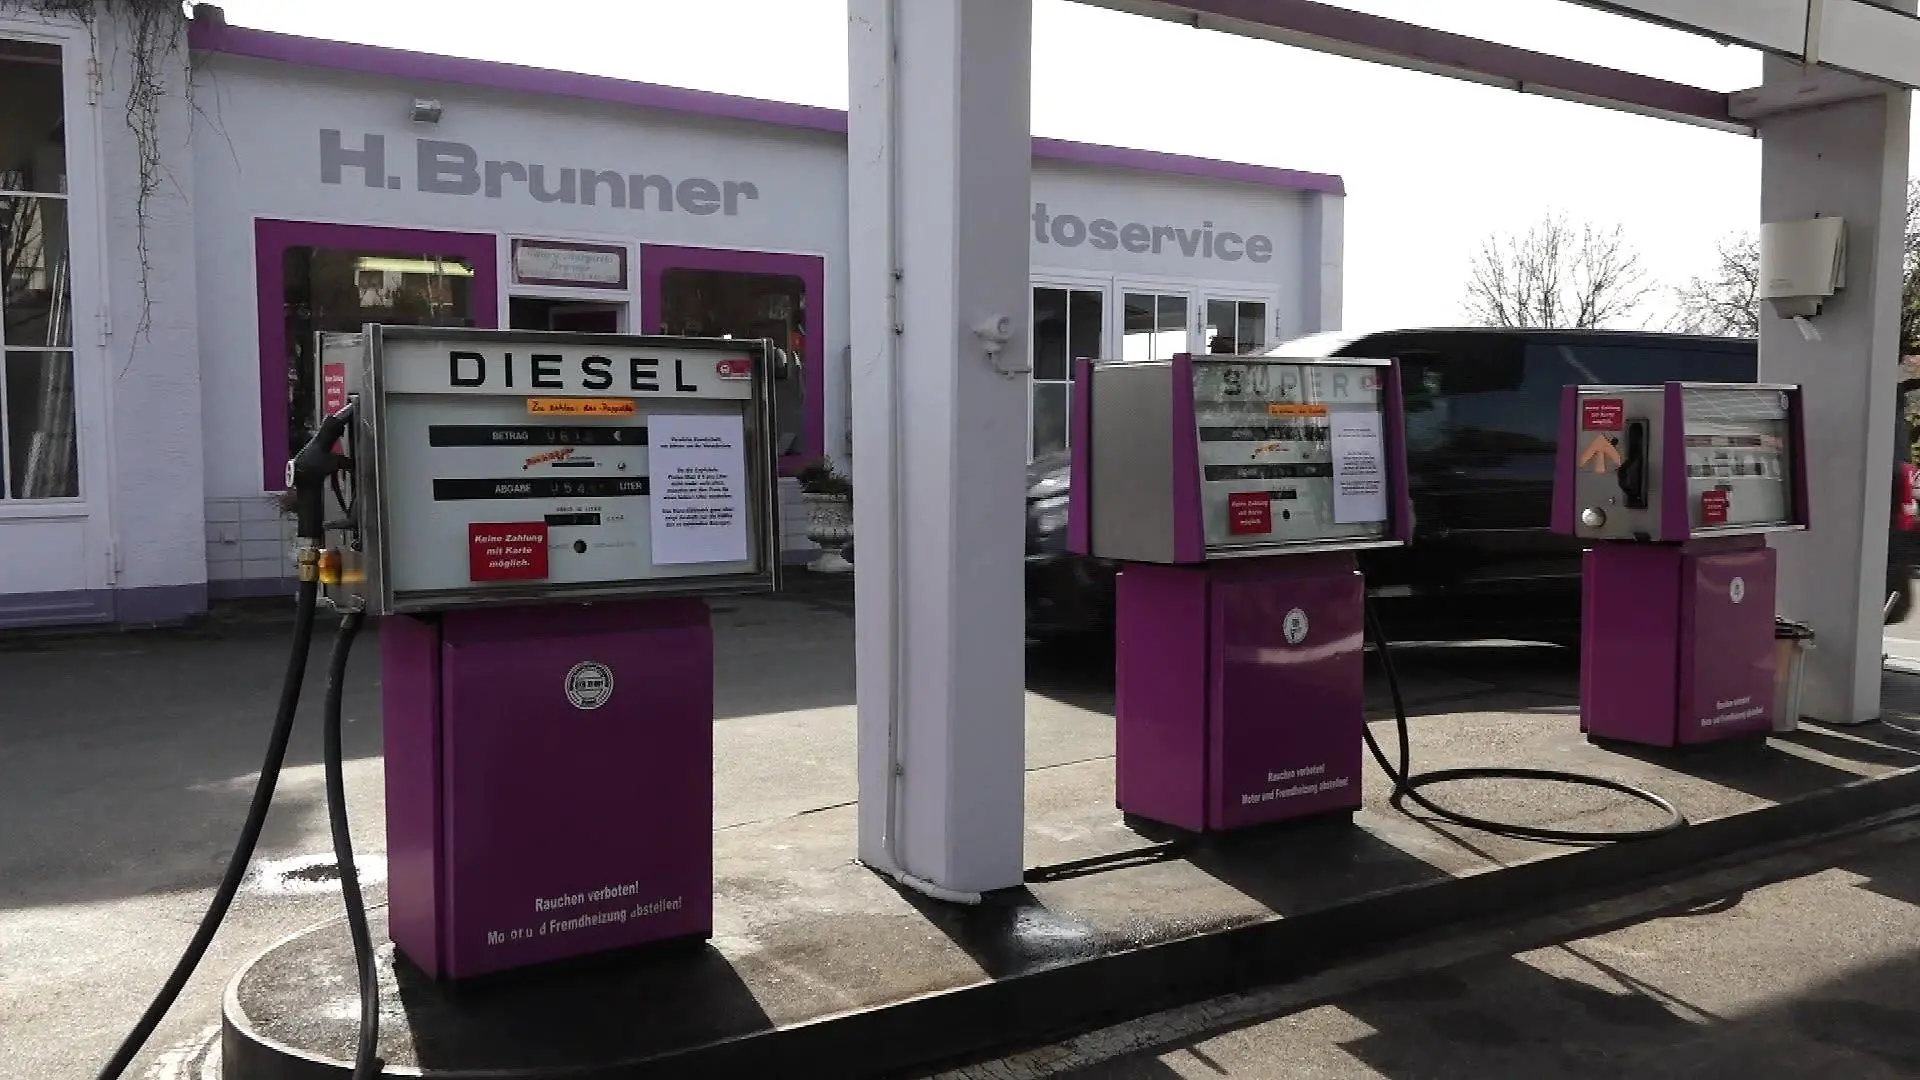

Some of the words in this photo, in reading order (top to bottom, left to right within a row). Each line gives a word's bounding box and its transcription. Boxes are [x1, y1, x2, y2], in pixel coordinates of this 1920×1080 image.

[320, 128, 401, 190] H.
[416, 138, 759, 216] Brunner
[450, 351, 698, 392] DIESEL
[1223, 368, 1349, 398] SUPER
[492, 431, 529, 440] BETRAG
[619, 481, 642, 490] LITER
[474, 535, 503, 543] Keine
[505, 534, 543, 543] Zahlung
[486, 547, 503, 555] mit
[505, 546, 533, 554] Karte
[535, 893, 585, 912] Rauchen
[588, 880, 640, 902] verboten!
[487, 928, 523, 946] Moor
[549, 909, 627, 934] Fremdheizung
